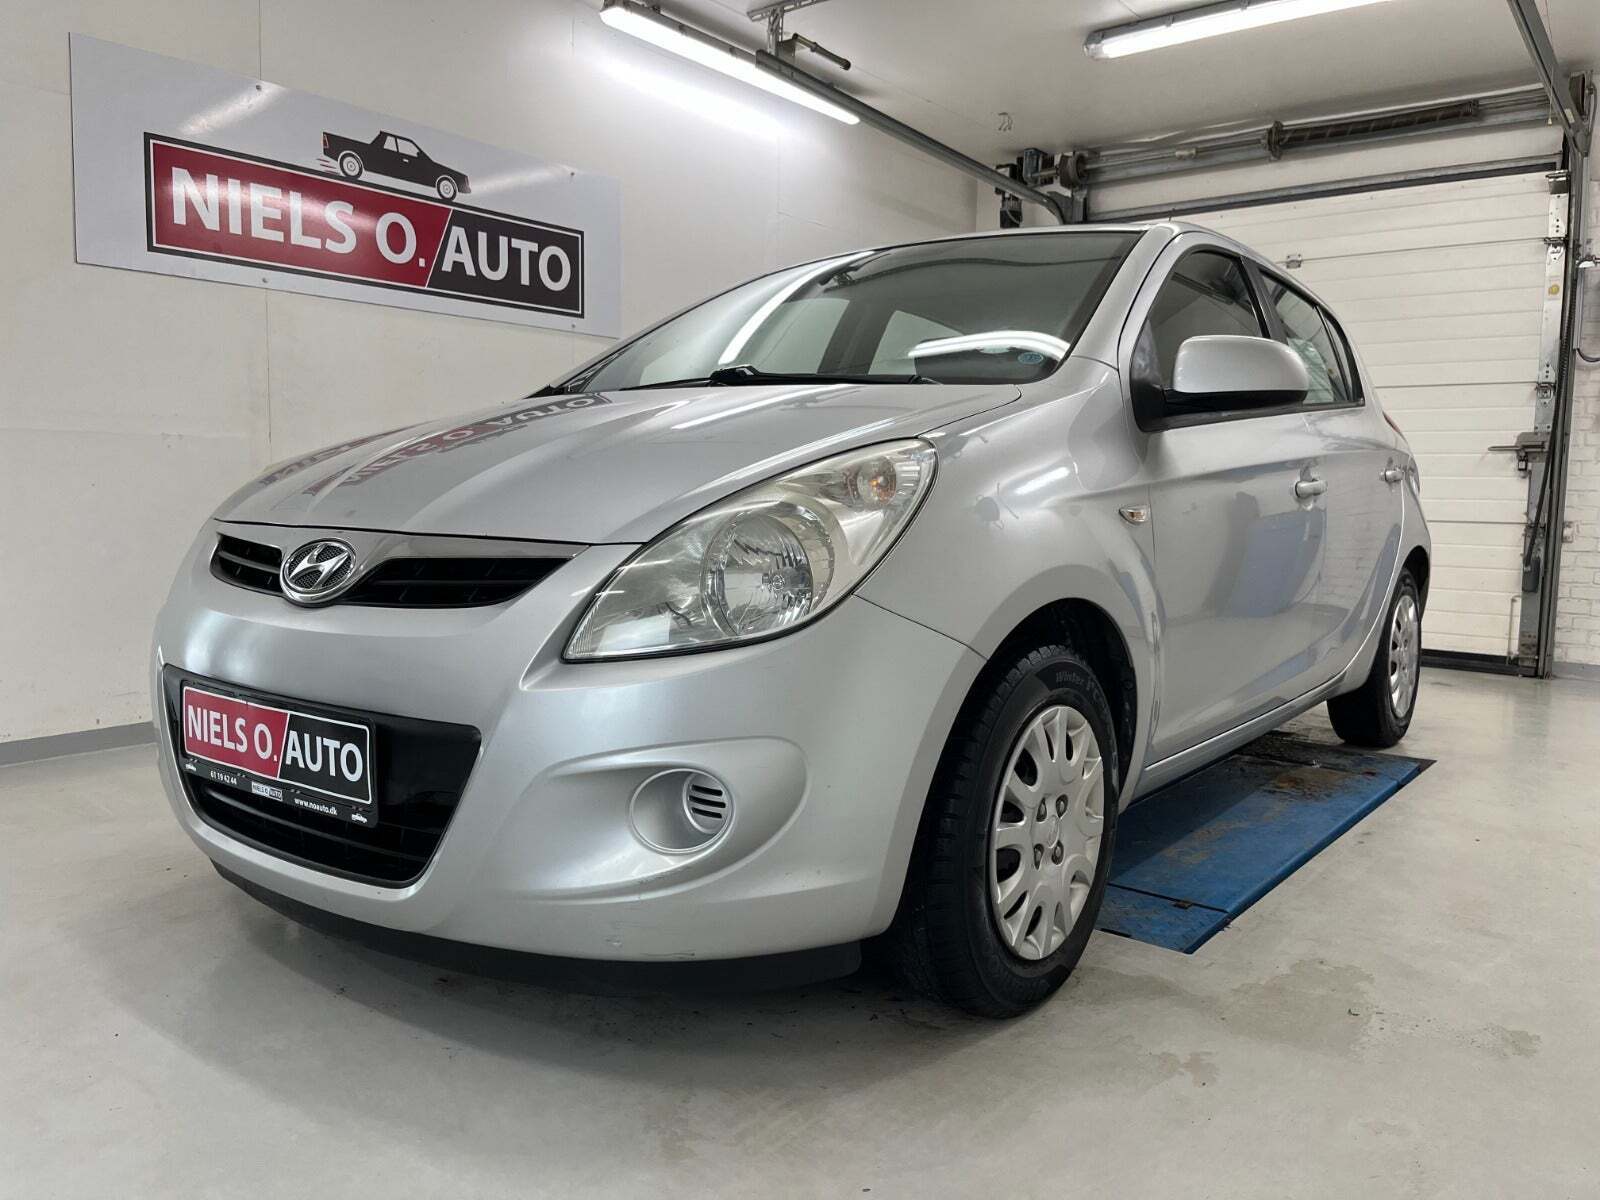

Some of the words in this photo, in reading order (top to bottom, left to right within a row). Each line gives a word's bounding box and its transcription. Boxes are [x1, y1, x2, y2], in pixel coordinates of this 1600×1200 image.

[171, 168, 357, 254] NIELS
[375, 212, 426, 267] O.
[441, 227, 571, 291] AUTO
[188, 705, 248, 752] NIELS
[254, 723, 278, 762] O.
[286, 731, 363, 781] AUTO
